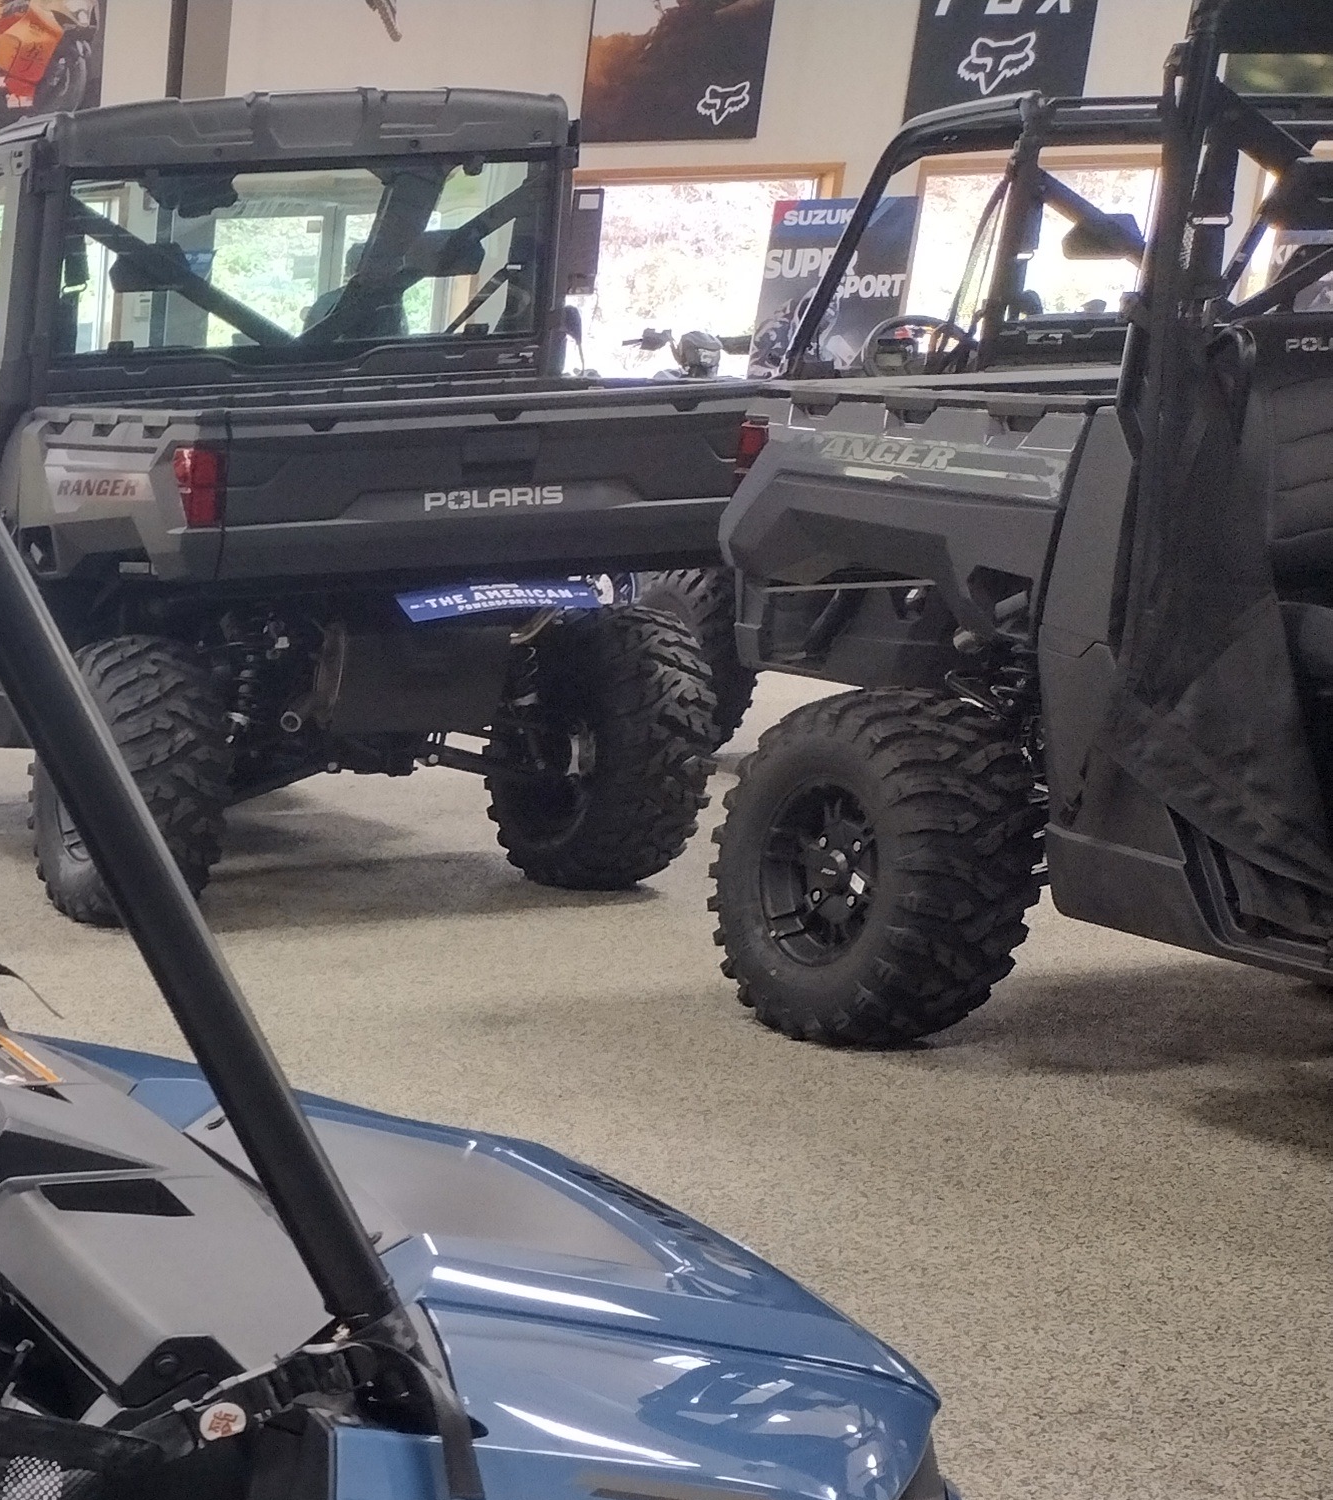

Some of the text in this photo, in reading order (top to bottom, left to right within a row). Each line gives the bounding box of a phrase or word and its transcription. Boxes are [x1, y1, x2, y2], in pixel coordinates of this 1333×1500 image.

[783, 208, 856, 226] SUZUK
[836, 273, 907, 299] SPORT
[56, 478, 138, 497] RANGER
[423, 485, 564, 512] POLARIS
[425, 588, 574, 608] THE AMERICAN
[457, 598, 558, 612] POWERSPORTS CO.
[207, 1410, 239, 1436] 验
